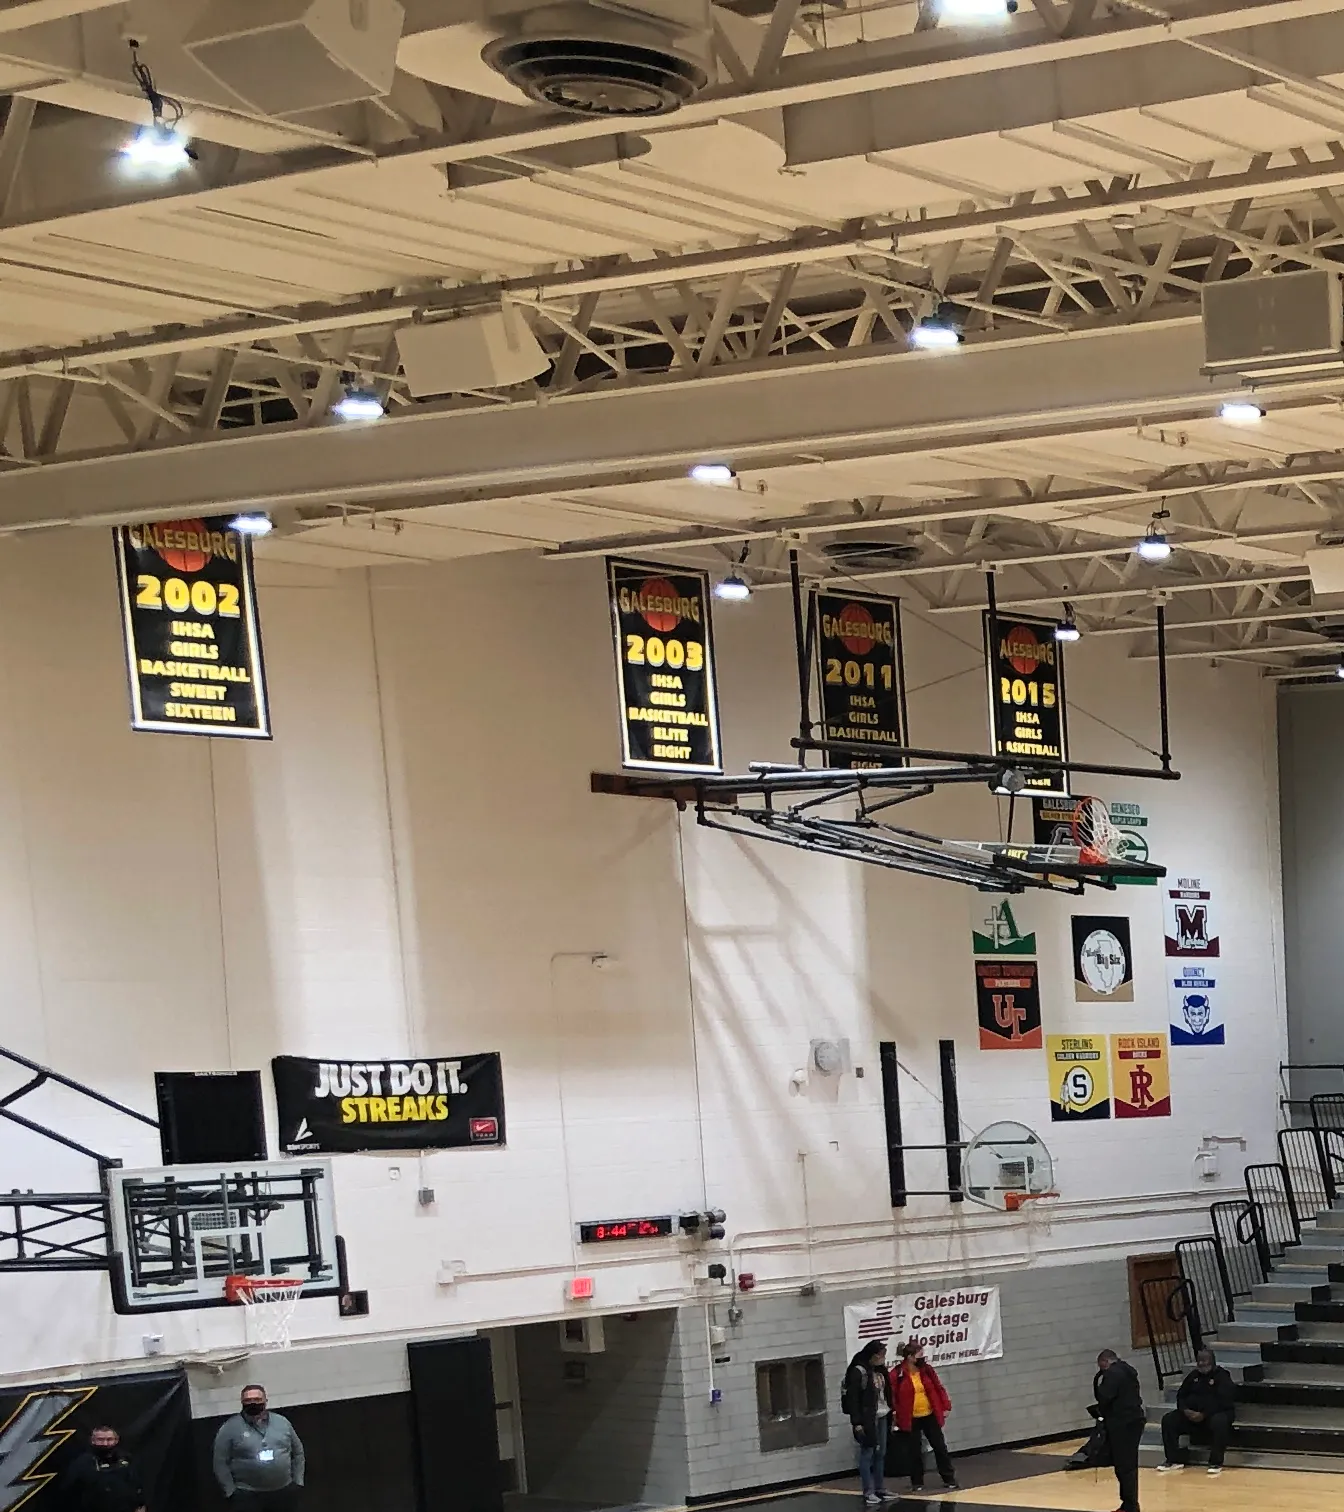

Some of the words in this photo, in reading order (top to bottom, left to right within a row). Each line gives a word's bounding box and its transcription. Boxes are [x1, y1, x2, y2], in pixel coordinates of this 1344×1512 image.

[129, 524, 237, 563] GALESBURG
[137, 575, 240, 618] 2002
[619, 587, 700, 622] GALESBURG
[172, 621, 215, 639] IHSA
[822, 614, 893, 647] GALESBURG
[170, 641, 219, 659] GIRLS
[627, 634, 703, 670] 2003
[1000, 639, 1054, 665] ALESBURG
[140, 659, 250, 682] BASKETBALL
[825, 658, 892, 691] 2011
[651, 674, 683, 689] IHSA
[170, 682, 227, 700] SWEET
[650, 691, 686, 707] GIRLS
[1001, 677, 1055, 708] 2015
[850, 695, 876, 708] IHSA
[165, 703, 236, 721] SIXTEEN
[629, 707, 708, 726] BASKETBALL
[849, 711, 879, 725] GIRLS
[1015, 711, 1040, 725] IHSA
[653, 727, 688, 741] ELITE
[829, 726, 898, 742] BASKETBALL
[1014, 727, 1042, 740] GIRLS
[653, 744, 691, 759] EIGHT
[315, 1063, 385, 1098] JUST
[389, 1062, 433, 1096] DO
[437, 1061, 468, 1094] IT.
[341, 1095, 448, 1123] STREAKS
[914, 1292, 988, 1311] Galesburg
[911, 1311, 969, 1329] Cottage
[909, 1328, 968, 1348] Hospital
